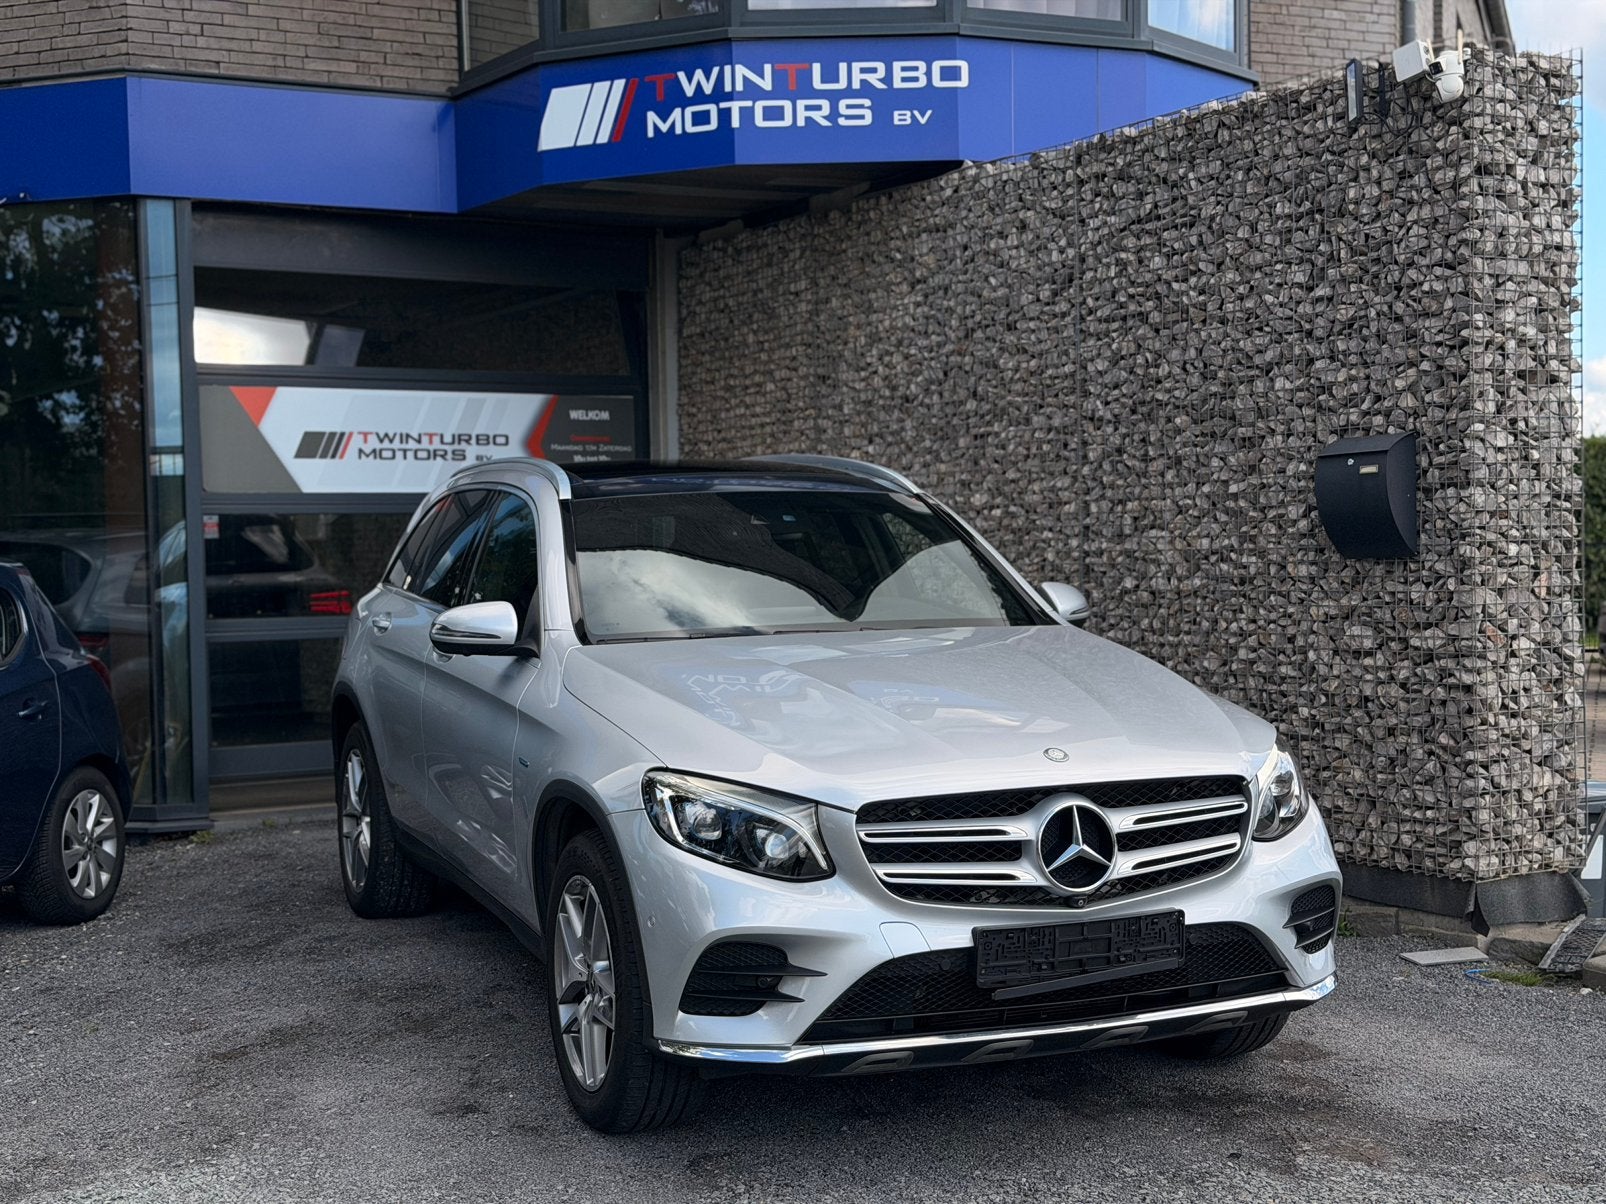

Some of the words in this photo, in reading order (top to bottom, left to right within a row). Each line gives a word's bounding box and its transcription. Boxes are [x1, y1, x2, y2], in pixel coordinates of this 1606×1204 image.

[644, 59, 970, 102] TWINTURBO
[645, 98, 873, 138] MOTORS
[893, 109, 933, 125] BV
[568, 409, 611, 421] WELKOM
[357, 431, 510, 447] TWINTURBO
[357, 448, 467, 462] MOTORS
